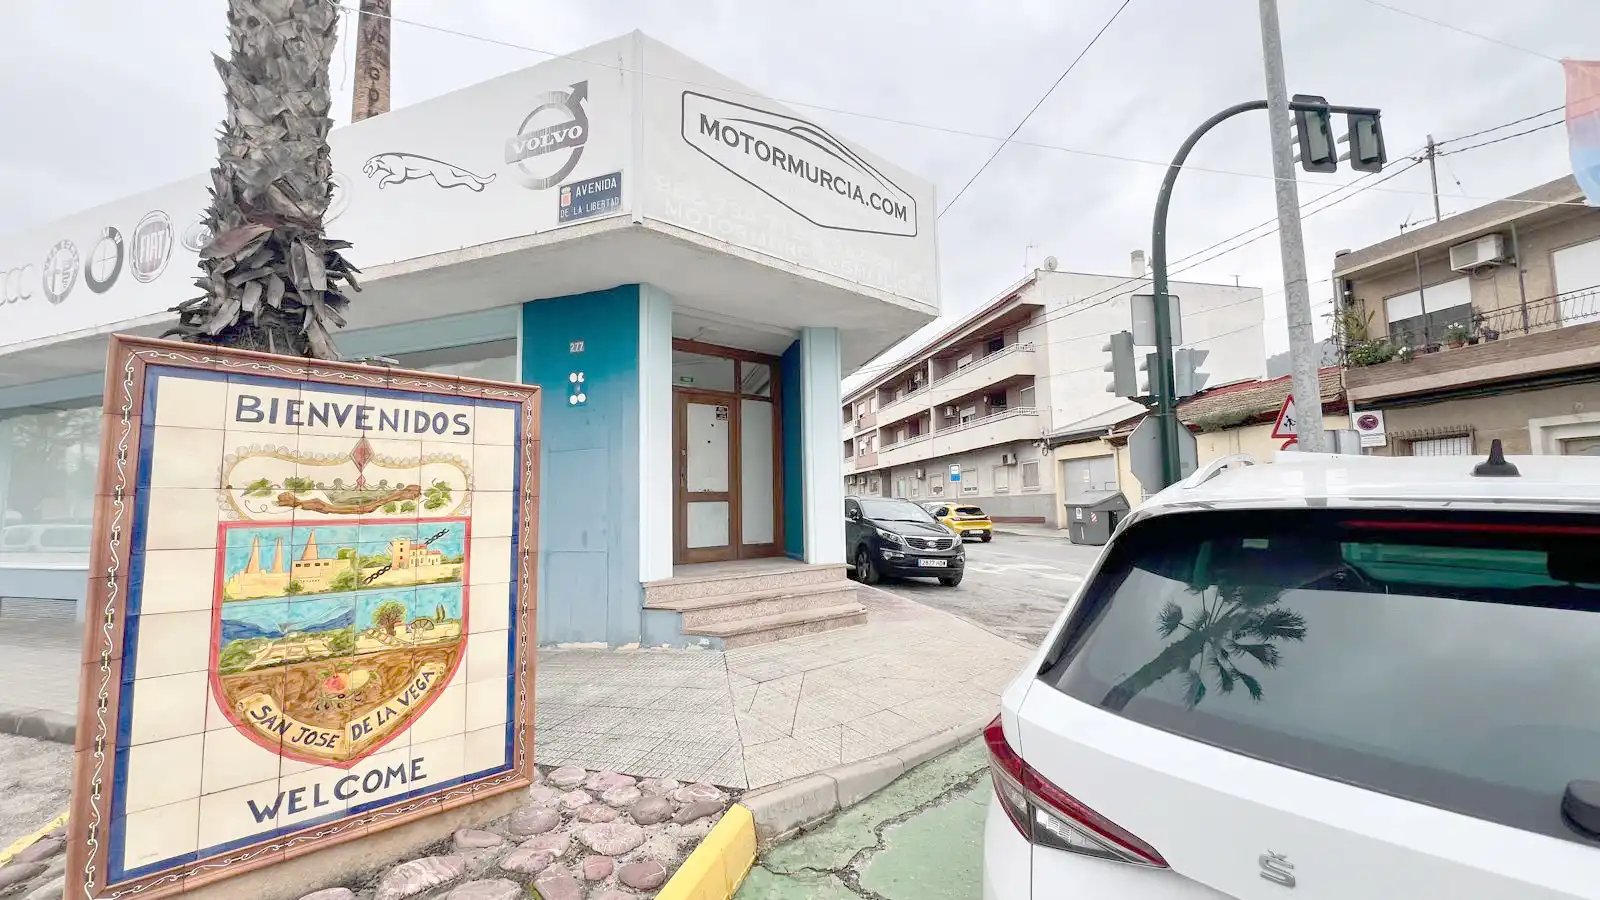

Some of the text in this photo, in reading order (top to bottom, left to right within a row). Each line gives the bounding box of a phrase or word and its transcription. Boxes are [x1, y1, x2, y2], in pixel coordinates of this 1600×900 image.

[511, 125, 583, 154] VOLVO
[699, 113, 908, 222] MOTORMURCIA.COM
[575, 177, 617, 198] AVENIDA
[560, 197, 619, 218] DE LA LIBERTAD
[139, 229, 167, 264] FIAT
[570, 341, 584, 352] 277
[235, 394, 471, 436] BIENVENIDOS
[250, 669, 435, 748] SAN JOSE DE LA VEGA
[247, 757, 428, 824] WELCOME
